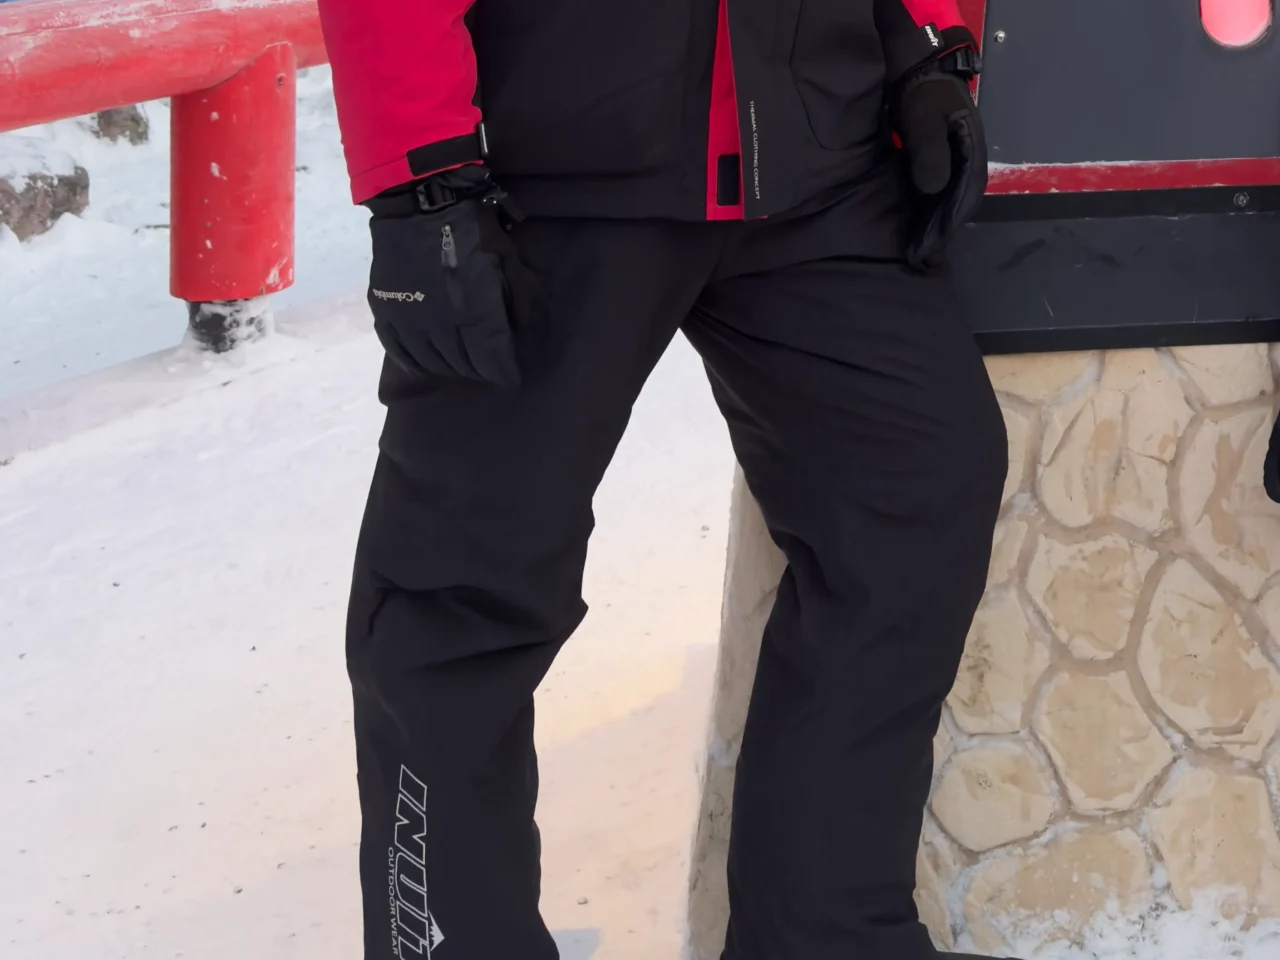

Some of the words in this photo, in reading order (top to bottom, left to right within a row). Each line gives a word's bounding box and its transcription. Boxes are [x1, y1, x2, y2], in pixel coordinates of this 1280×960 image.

[925, 25, 939, 47] INUIT
[749, 100, 757, 132] THERMAL
[372, 289, 414, 302] Columbia
[387, 846, 396, 915] OUTDOOR
[390, 917, 399, 955] WEAR
